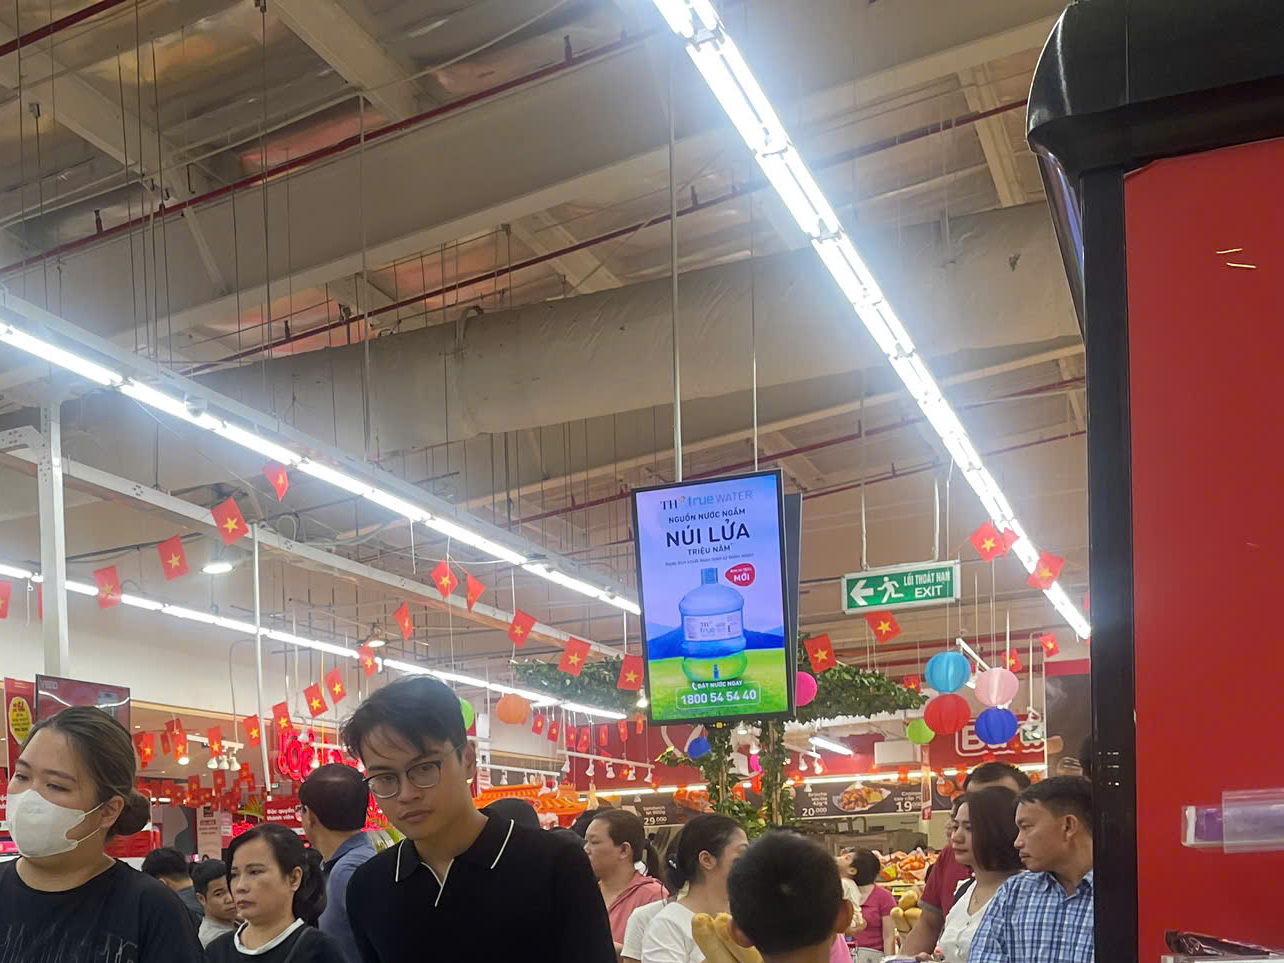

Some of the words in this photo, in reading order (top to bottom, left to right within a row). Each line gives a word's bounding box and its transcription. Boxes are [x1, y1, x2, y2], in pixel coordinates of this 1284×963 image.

[666, 524, 701, 547] NÚI
[708, 518, 750, 543] LỬA
[733, 571, 750, 582] MỚI
[915, 585, 943, 599] EXIT
[681, 693, 708, 705] 1800
[710, 691, 724, 703] 54
[726, 690, 740, 702] 54
[742, 689, 757, 700] 40
[802, 807, 815, 817] 20
[896, 801, 912, 812] 19
[644, 817, 656, 826] 29
